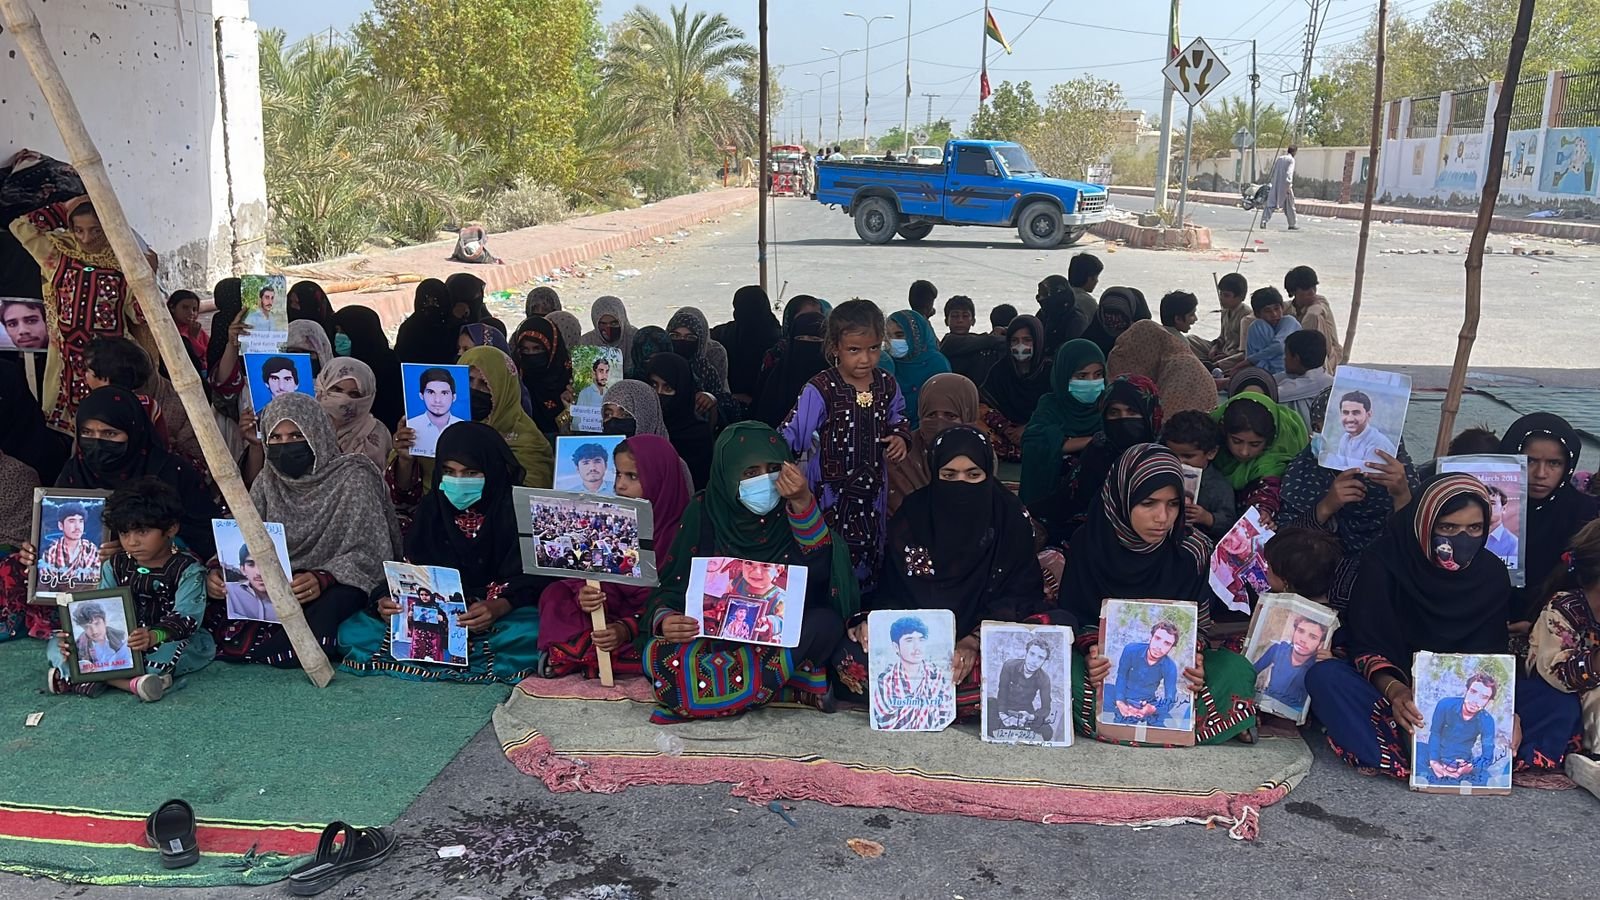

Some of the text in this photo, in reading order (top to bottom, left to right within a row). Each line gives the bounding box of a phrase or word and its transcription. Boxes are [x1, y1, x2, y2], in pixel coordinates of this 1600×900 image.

[1478, 473, 1499, 482] March
[888, 696, 944, 706] Muslim Arif
